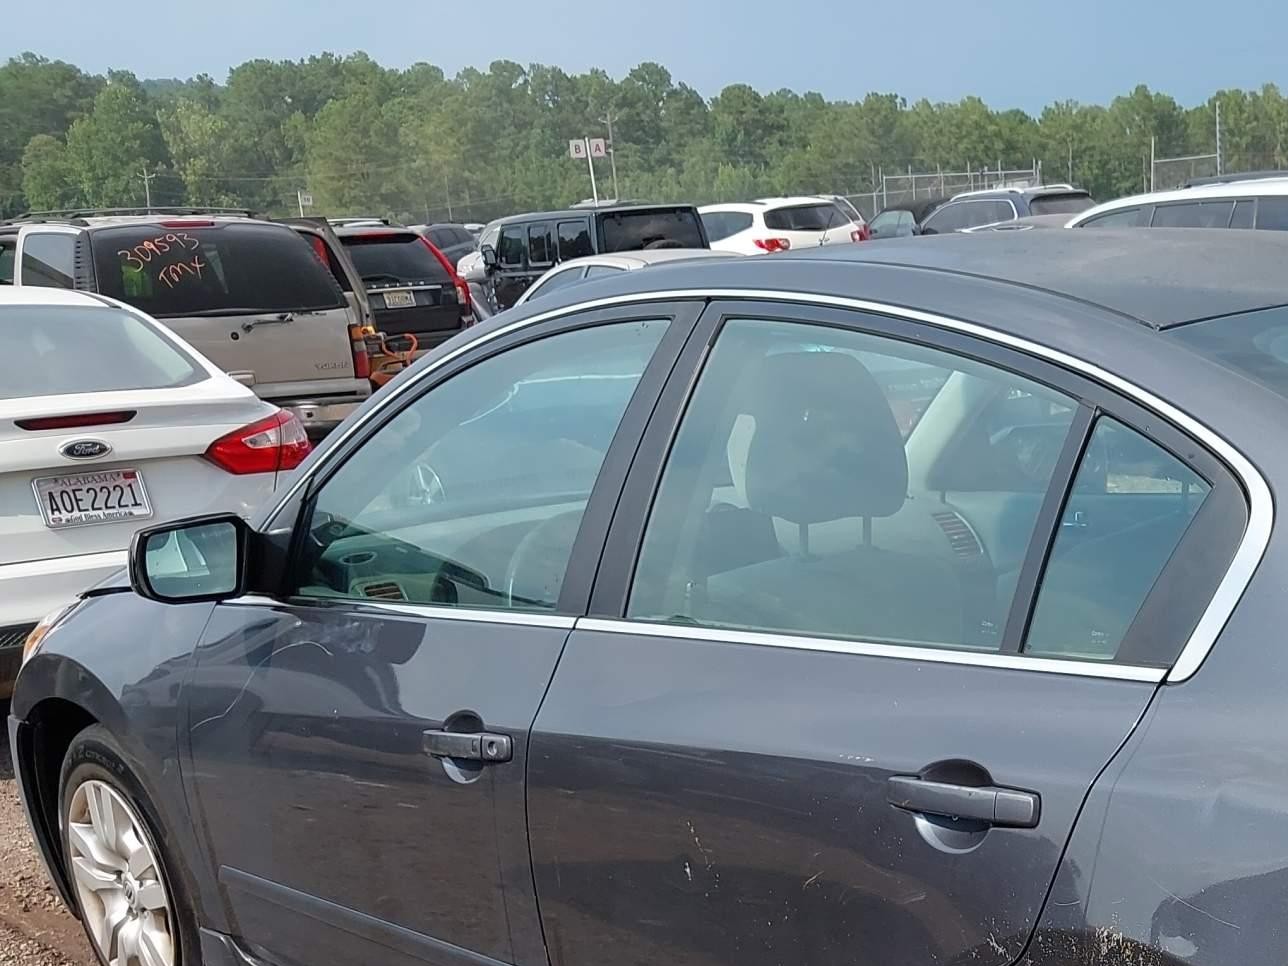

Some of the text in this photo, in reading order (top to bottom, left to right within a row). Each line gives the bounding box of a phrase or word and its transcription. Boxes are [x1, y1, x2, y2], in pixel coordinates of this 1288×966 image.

[574, 144, 582, 154] B
[594, 143, 602, 153] A
[73, 442, 101, 456] Ford
[60, 473, 118, 487] ALABAMA
